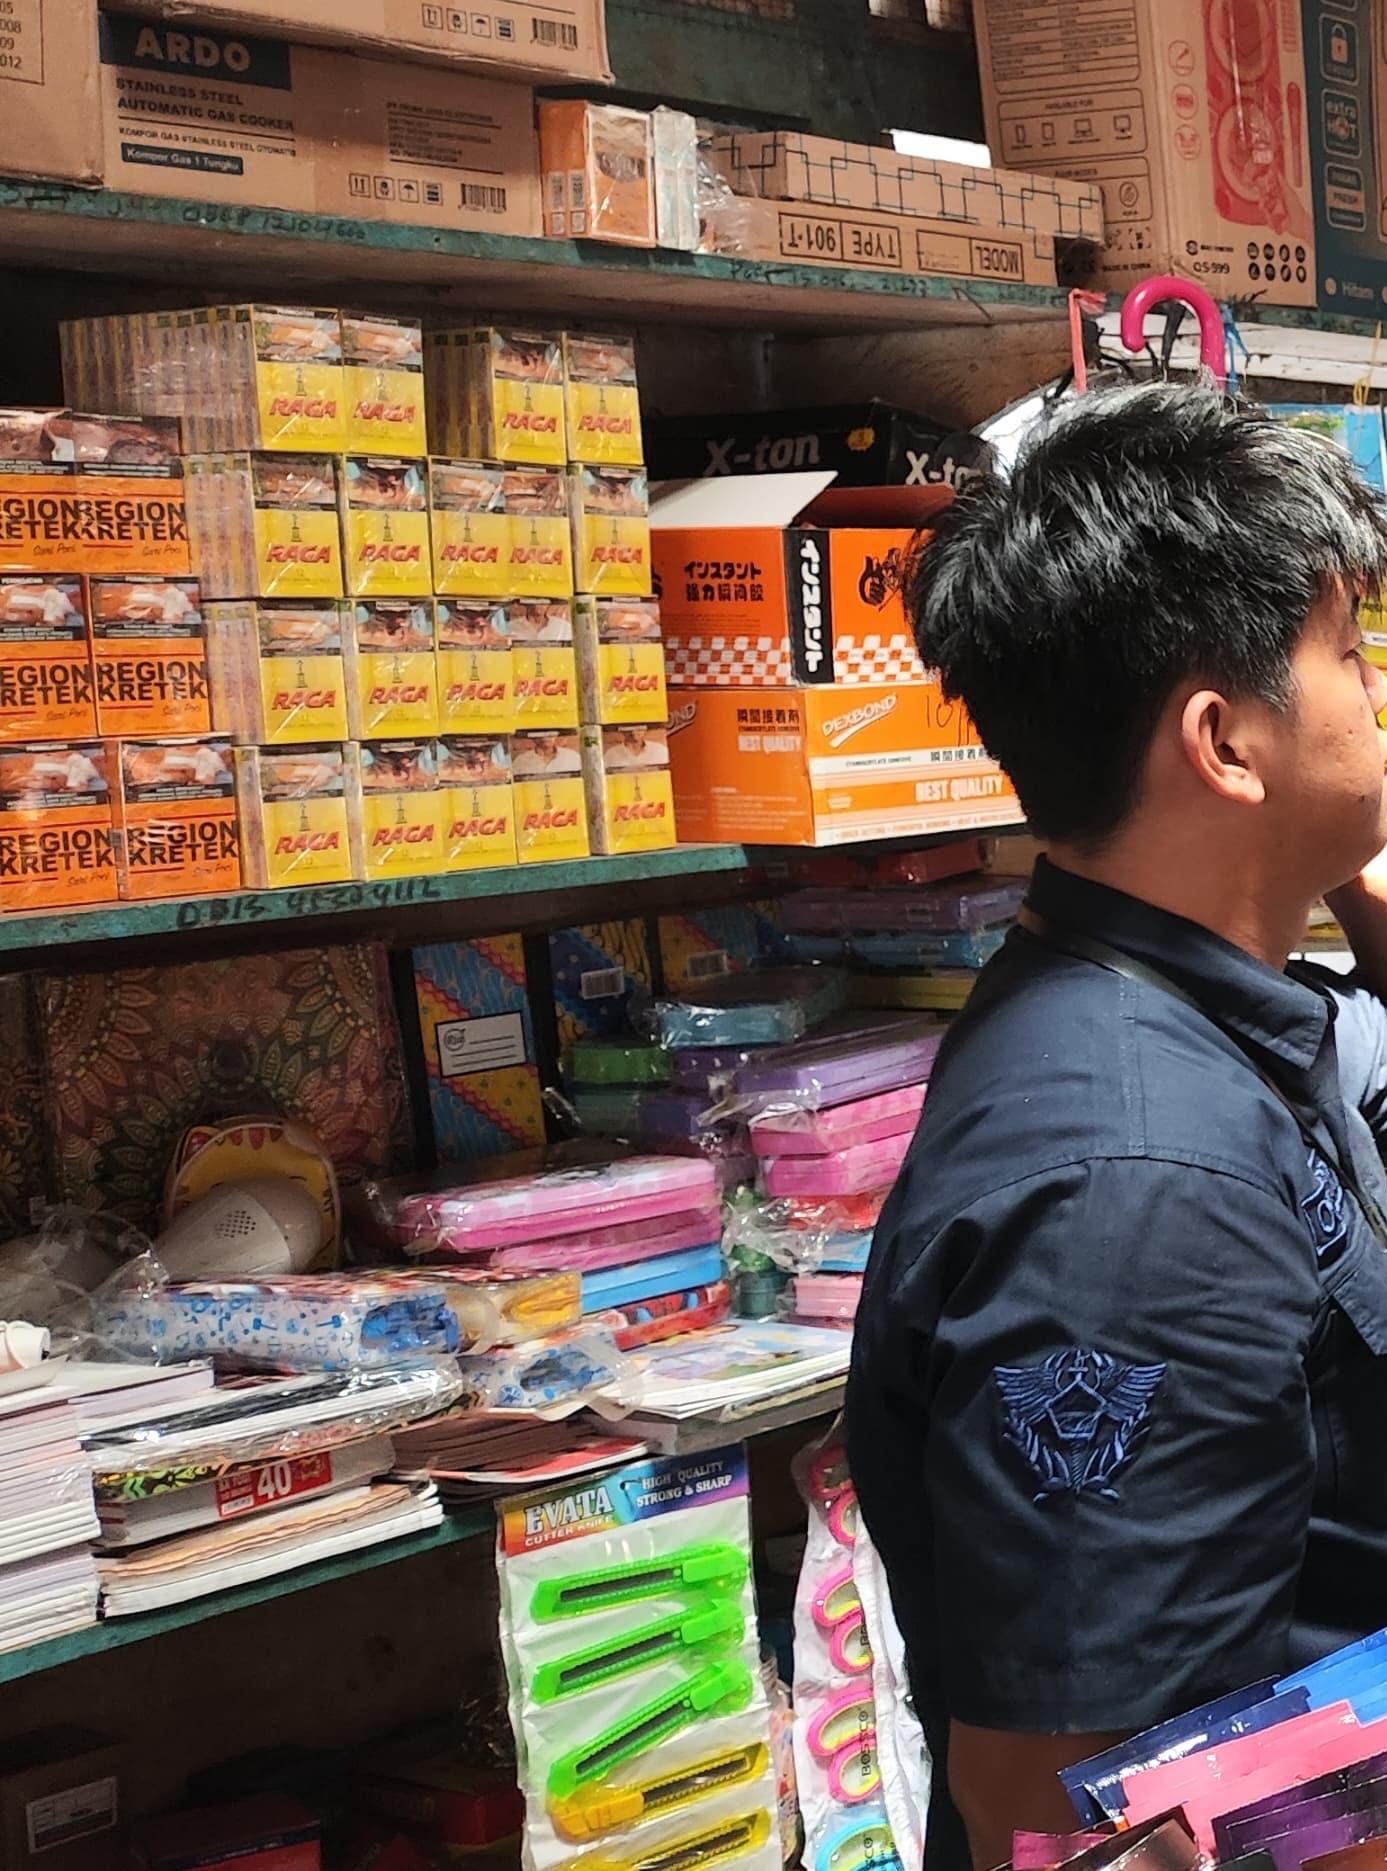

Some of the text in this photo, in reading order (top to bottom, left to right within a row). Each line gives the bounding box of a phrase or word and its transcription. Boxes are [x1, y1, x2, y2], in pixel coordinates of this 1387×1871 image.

[134, 26, 250, 72] ARDO
[116, 77, 243, 105] STAINLESS STEEL
[117, 97, 294, 132] AUTOMATIC GAS COOKER
[160, 132, 180, 143] GAS
[127, 147, 169, 165] Kompor
[171, 152, 192, 166] Gas
[202, 155, 241, 172] Tungku
[851, 231, 897, 260] TYPE
[974, 245, 1020, 274] MODEL
[269, 397, 337, 420] RAGA
[353, 399, 417, 424] RAGA
[502, 411, 558, 434] RAGA
[577, 413, 633, 434] RAGA
[701, 432, 821, 477] X-ton
[905, 450, 984, 490] X-t
[0, 498, 79, 521] GION
[0, 519, 86, 541] ETEK
[266, 541, 332, 564] RAGA
[358, 541, 422, 563] RAGA
[440, 543, 500, 564] RAGA
[509, 544, 564, 566] RAGA
[590, 544, 643, 565] RAGA
[0, 664, 90, 687] EGION
[96, 661, 207, 684] REGION
[607, 673, 659, 694] RAGA
[0, 684, 92, 707] RETEK
[98, 681, 208, 701] KRETEK
[271, 688, 337, 710] RAGA
[369, 683, 430, 705] RAGA
[446, 682, 507, 703] RAGA
[513, 677, 570, 698] RAGA
[821, 694, 898, 737] DEXBOND
[915, 774, 1005, 803] BEST QUALITY
[522, 808, 579, 831] RAGA
[613, 801, 667, 823] RAGA
[126, 820, 239, 848] REGION
[371, 823, 435, 847] RAGA
[448, 815, 508, 838] RAGA
[0, 827, 113, 854] REGION
[274, 832, 341, 855] RAGA
[0, 849, 115, 877] KRETEK
[129, 840, 239, 867] KRETEK
[256, 1461, 292, 1500] 40
[641, 1460, 726, 1490] HIGH QUALITY
[635, 1486, 682, 1508] STRONG
[695, 1473, 733, 1494] SHARP
[524, 1486, 615, 1536] EVATA
[524, 1525, 575, 1547] CUTTER
